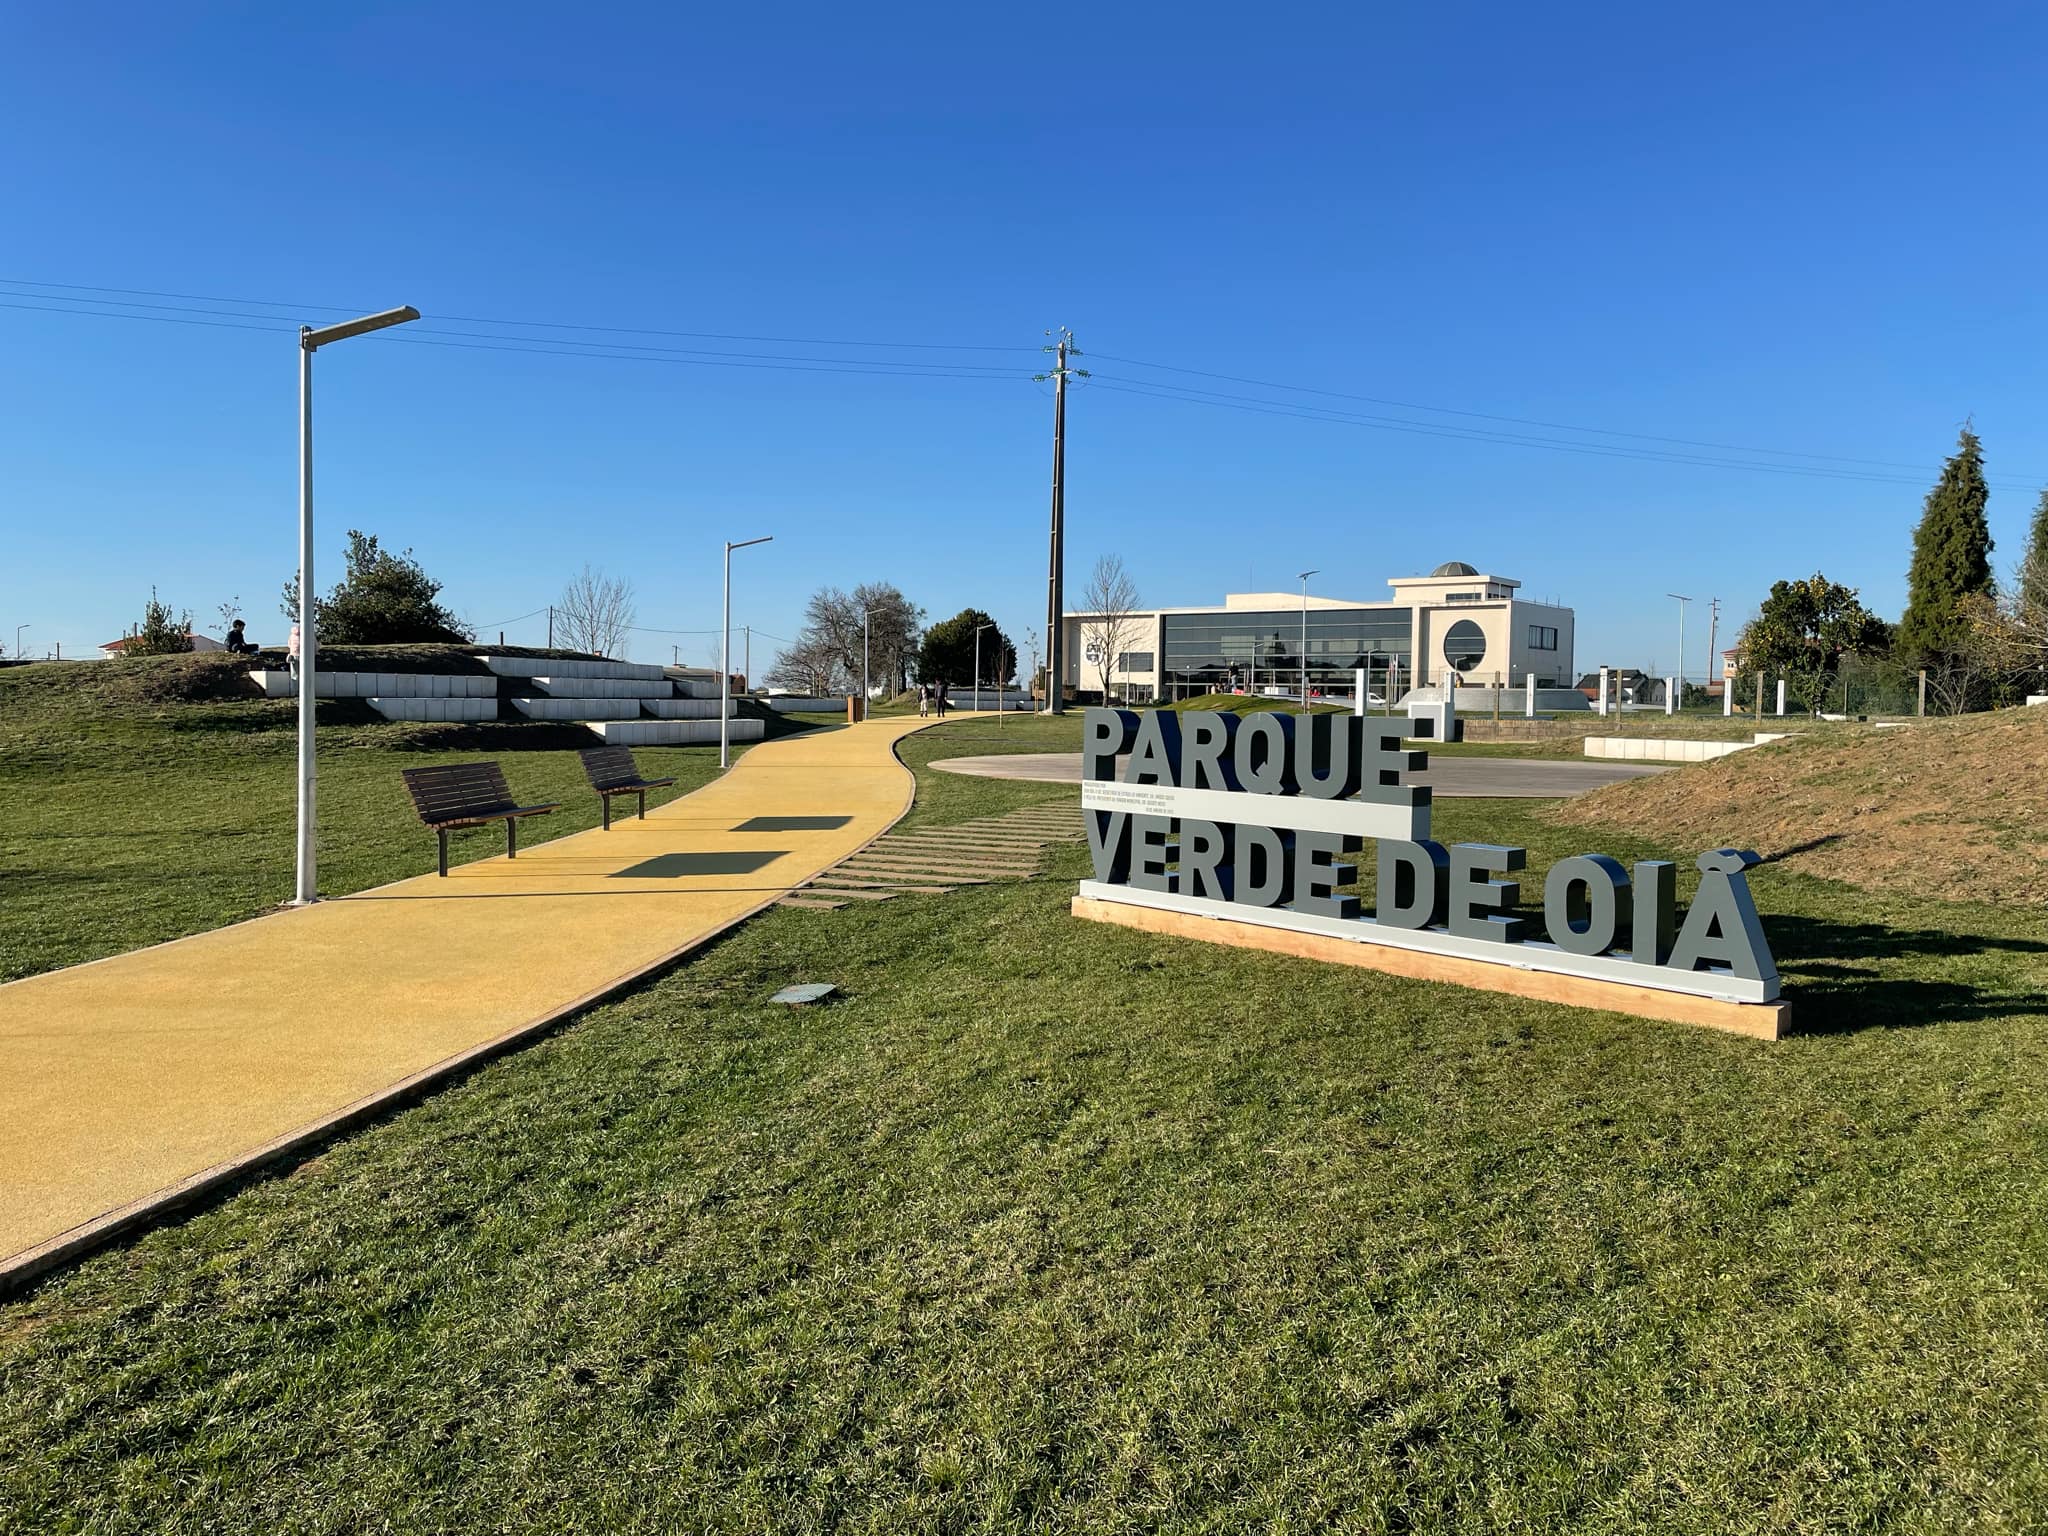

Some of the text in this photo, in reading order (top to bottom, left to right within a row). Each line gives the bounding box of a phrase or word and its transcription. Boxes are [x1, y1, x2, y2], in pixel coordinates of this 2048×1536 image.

[1083, 709, 1432, 804] PARQUE
[1083, 809, 1774, 981] VERDE DE OIÃ
